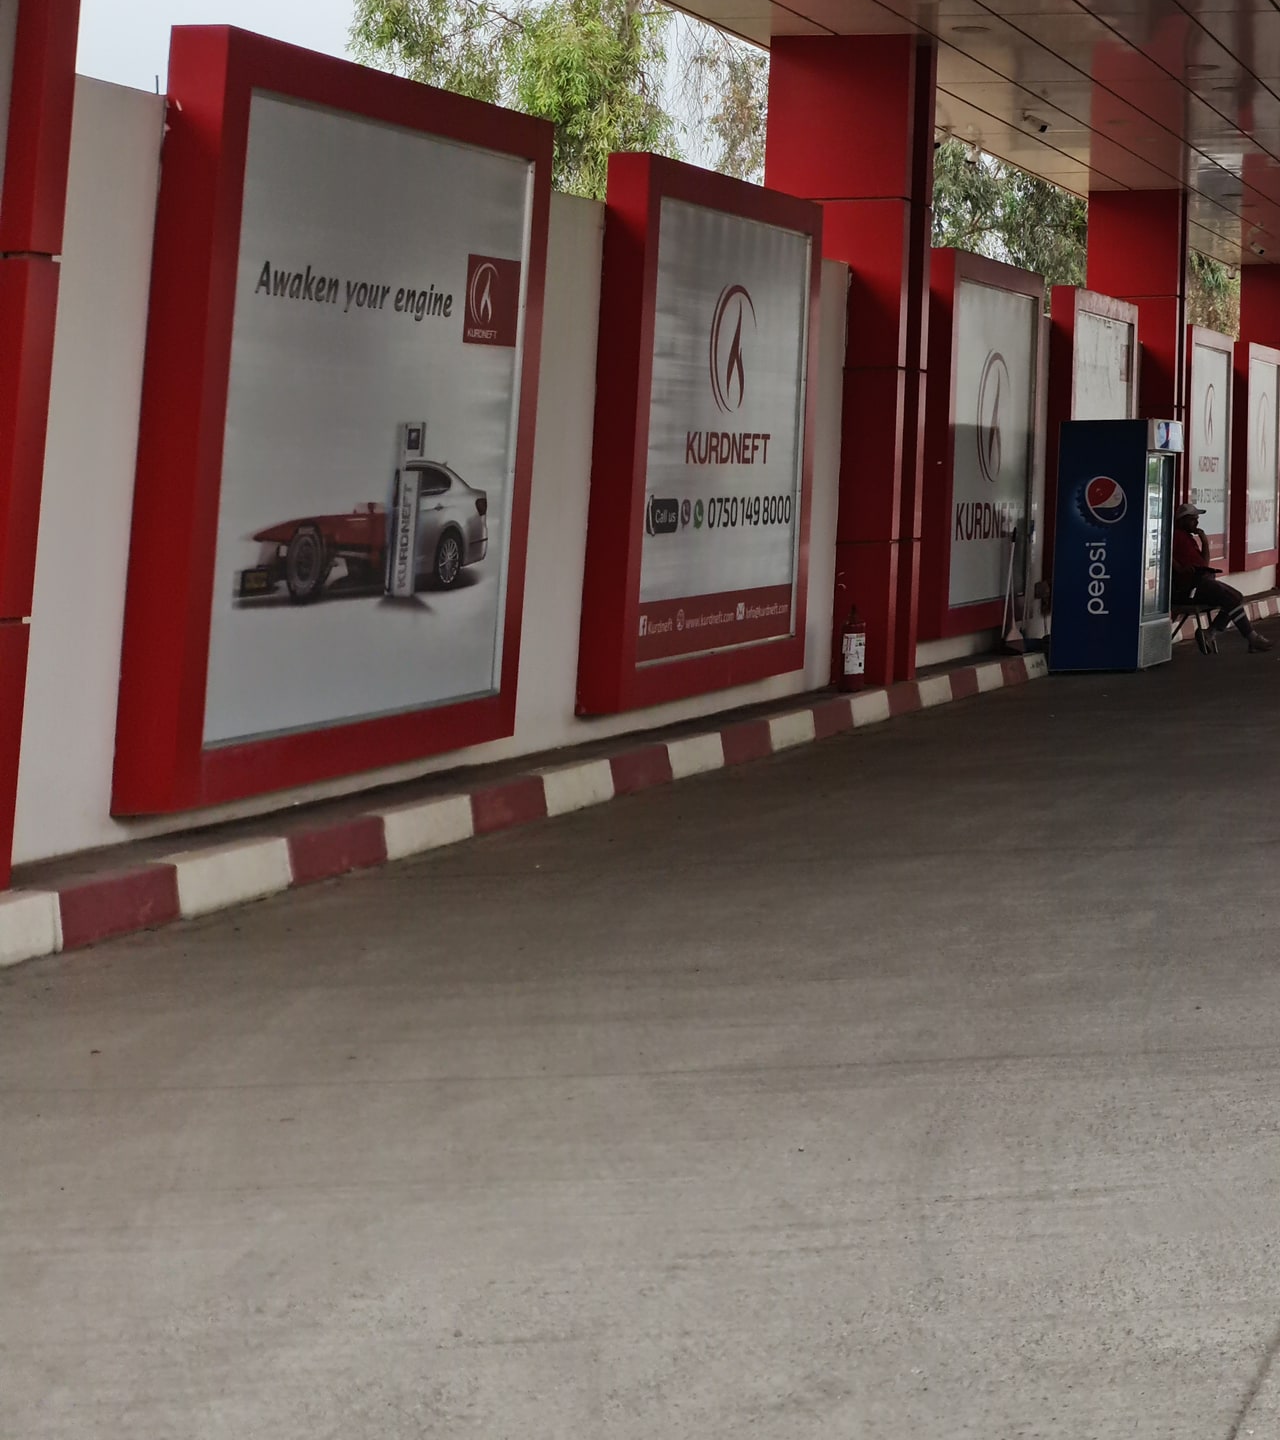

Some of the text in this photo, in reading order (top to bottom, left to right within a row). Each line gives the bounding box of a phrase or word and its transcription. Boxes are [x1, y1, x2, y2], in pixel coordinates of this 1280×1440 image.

[254, 261, 453, 322] Awaken your engine
[685, 431, 771, 465] KURDNEFT
[397, 482, 413, 589] KURDNEFT
[655, 495, 791, 528] Call us 0750 149 8000
[1086, 542, 1110, 615] pepsi
